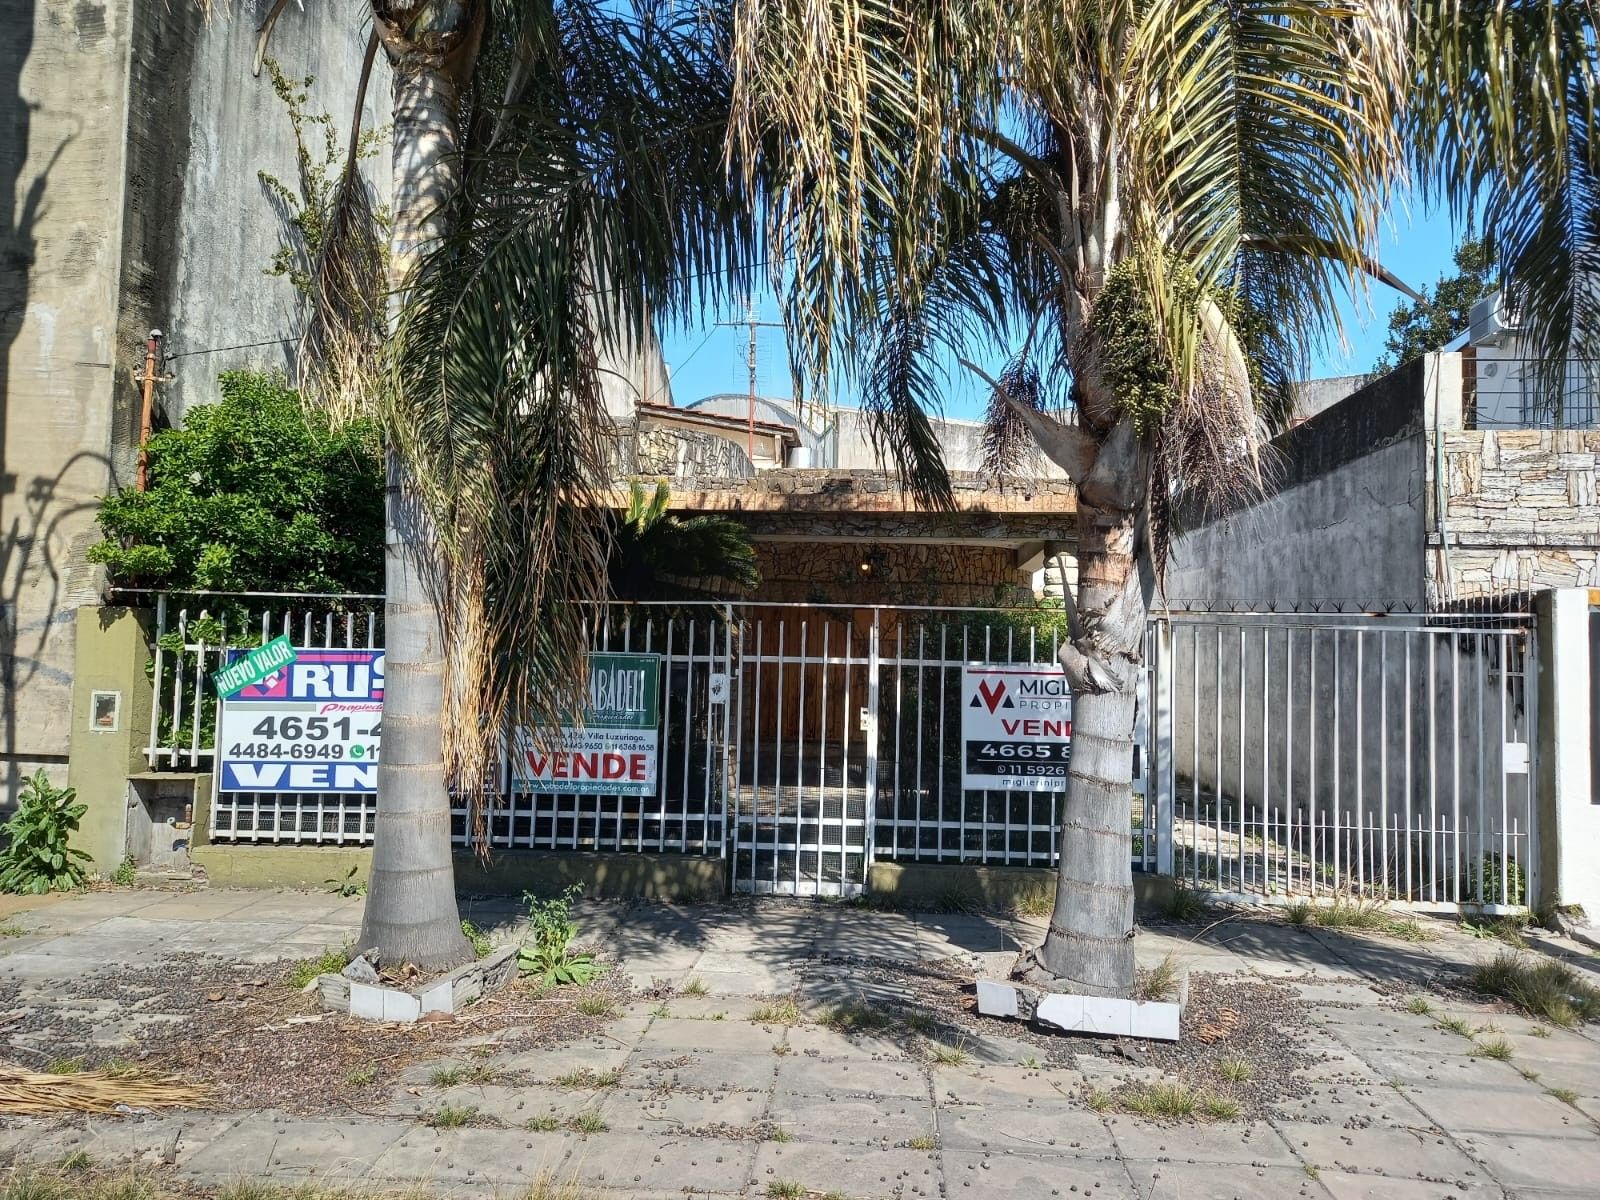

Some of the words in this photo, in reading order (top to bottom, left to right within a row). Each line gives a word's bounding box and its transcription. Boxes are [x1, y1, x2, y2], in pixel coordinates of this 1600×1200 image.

[216, 660, 256, 694] NUEVO
[253, 640, 292, 673] VALOR
[588, 732, 604, 740] Villa
[229, 743, 343, 759] 4484-6949
[981, 743, 1051, 758] 4665
[525, 751, 646, 780] VENDE
[1009, 764, 1022, 774] 11
[1027, 765, 1065, 775] 5926
